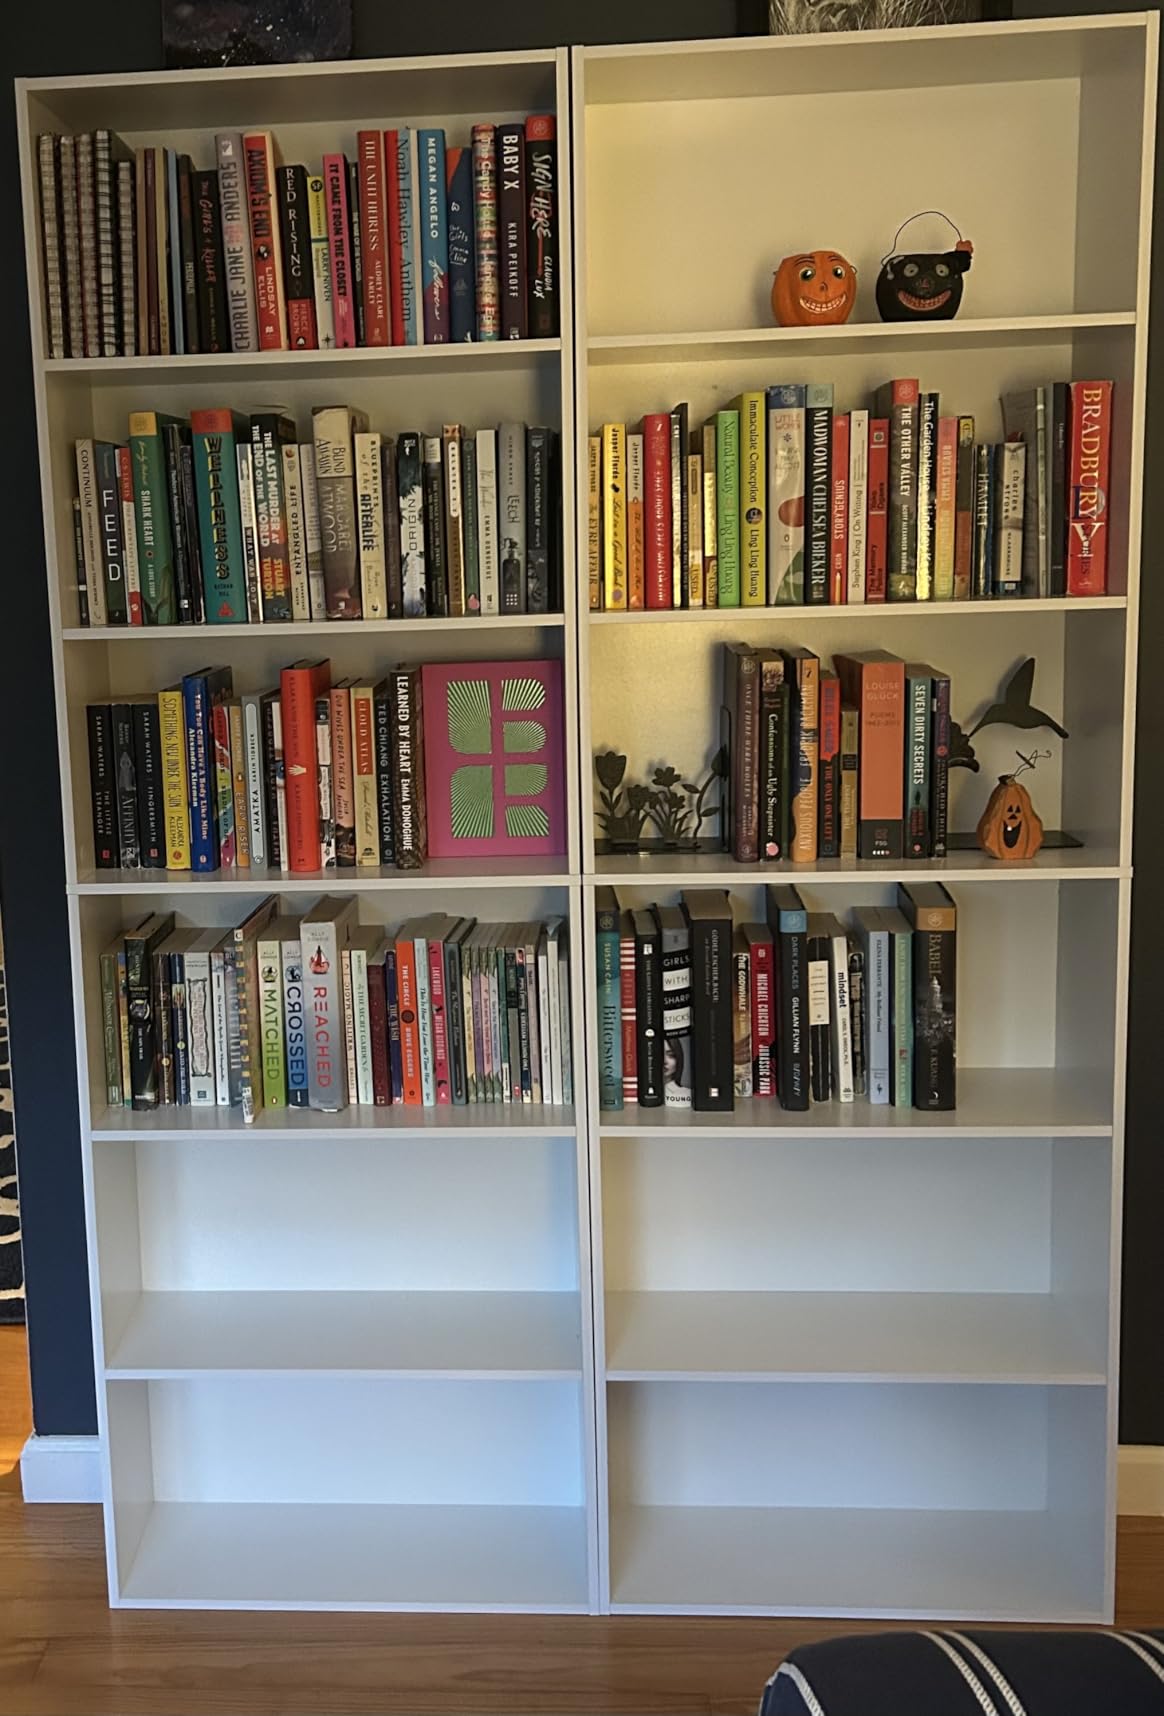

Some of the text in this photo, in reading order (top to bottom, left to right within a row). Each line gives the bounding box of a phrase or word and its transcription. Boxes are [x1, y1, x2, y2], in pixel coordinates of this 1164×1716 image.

[329, 164, 339, 173] IT
[330, 177, 340, 204] CAME
[427, 138, 438, 238] MEGAN ANGELO
[480, 137, 491, 198] The Candy
[503, 135, 519, 190] BABY X
[286, 168, 301, 277] RED RISING
[332, 208, 342, 236] FROM
[365, 140, 379, 250] THE UNFIT HEIRESS
[530, 152, 553, 240] SIGN HERE
[221, 163, 250, 350] CHARLIE JANE ANDERS
[334, 240, 343, 257] THE
[396, 139, 413, 321] Noah Hawley Anthem
[336, 259, 346, 296] CLOSET
[508, 222, 518, 298] KIRA PEIKOFF
[544, 256, 553, 291] CLAUDIA
[258, 276, 266, 308] ELLIS
[266, 267, 275, 316] LINDSAY
[534, 279, 545, 299] LUX
[252, 425, 260, 441] THE
[923, 402, 934, 420] The
[253, 443, 263, 467] END
[611, 427, 620, 480] Jasper Fforde
[722, 420, 736, 496] Natural Beauty
[749, 400, 759, 503] Immaculate Conception
[900, 407, 911, 497] THE OTHER VALLEY
[923, 422, 933, 457] Garden
[1080, 388, 1102, 521] BRADBURY
[80, 450, 92, 508] CONTINUUM
[255, 470, 264, 483] OF
[264, 432, 280, 544] THE LAST MURDER AT
[371, 440, 379, 507] BLUEPRINTS
[811, 410, 828, 584] MADWOMAN CHELSEA BIEKER
[977, 473, 989, 527] HAMLET
[141, 490, 154, 546] SHARK HEART
[204, 437, 230, 580] WELLNESS
[257, 502, 270, 547] WORLD
[290, 485, 302, 576] ENTANGLED LIFE
[360, 494, 375, 551] AFTERLIFE
[408, 499, 417, 550] ORIGIN
[507, 495, 520, 524] LEECH
[834, 479, 845, 539] STORY GENIUS
[853, 490, 862, 518] Writing
[853, 520, 861, 531] On
[103, 489, 121, 581] FEED
[720, 514, 736, 595] Ling Ling Huang
[749, 529, 759, 597] Ling Ling Huang
[852, 540, 862, 556] King
[263, 557, 273, 599] TURTON
[274, 558, 285, 597] STUART
[852, 559, 861, 588] Stephen
[194, 693, 202, 709] You
[397, 676, 411, 773] LEARNED BY HEART
[95, 716, 105, 777] SARAH WATERS
[162, 697, 181, 808] SOMETHING NEW UNDER THE SUN
[189, 728, 197, 770] Alexandra
[197, 747, 205, 768] Have
[335, 694, 346, 790] OUR WIVES UNDER THE SEA
[358, 701, 369, 774] CLOUD ATLAS
[913, 685, 926, 785] SEVEN DIRTY SECRETS
[199, 778, 207, 798] Body
[378, 704, 391, 842] TED CHIANG EXHALATION
[766, 713, 778, 837] Confessions Ugly Stepsister
[121, 796, 135, 846] AFFINITY
[147, 786, 156, 842] FINGERSMITH
[169, 816, 177, 848] KLEEMAN
[252, 789, 260, 833] AMATKA
[400, 778, 413, 850] EMMA DONOGHUE
[799, 778, 813, 851] ANXIOUS PEOPLE
[663, 956, 690, 967] GIRLS
[664, 975, 688, 986] WITH
[738, 956, 746, 1011] THE GODWHALE
[929, 934, 941, 978] BABEL
[664, 994, 690, 1005] SHARP
[791, 936, 800, 1054] DARK PLACES GILLIAN FLYNN
[837, 972, 847, 1008] mindset
[264, 990, 279, 1080] MATCHED
[287, 986, 304, 1085] CROSSED
[314, 986, 331, 1087] REACHED
[402, 981, 410, 1006] CIRCLE
[406, 1049, 414, 1077] EGGERS
[603, 1004, 616, 1088] Bittersweet
[663, 1014, 690, 1024] STICKS
[757, 973, 771, 1095] MICHAEL CRICHTON JURASSIC PARK
[665, 1095, 691, 1103] YOUNG
